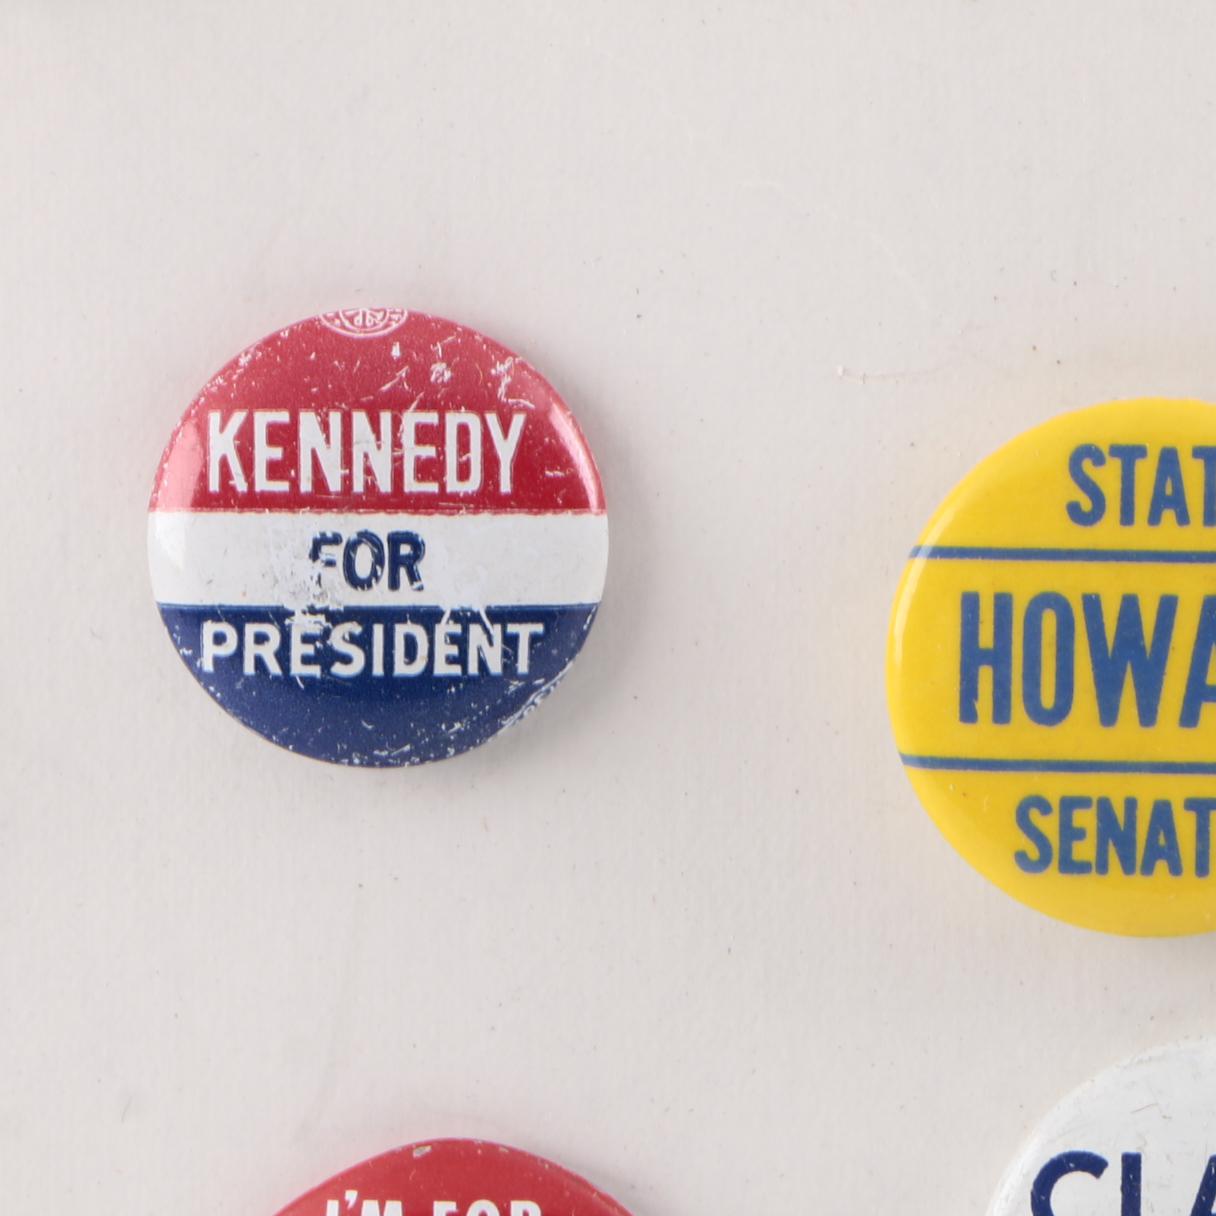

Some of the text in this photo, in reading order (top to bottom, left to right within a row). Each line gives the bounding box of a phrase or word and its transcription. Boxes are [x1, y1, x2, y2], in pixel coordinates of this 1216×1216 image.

[207, 410, 527, 494] KENNEDY
[311, 529, 426, 592] FOR
[202, 621, 545, 677] PRESIDENT
